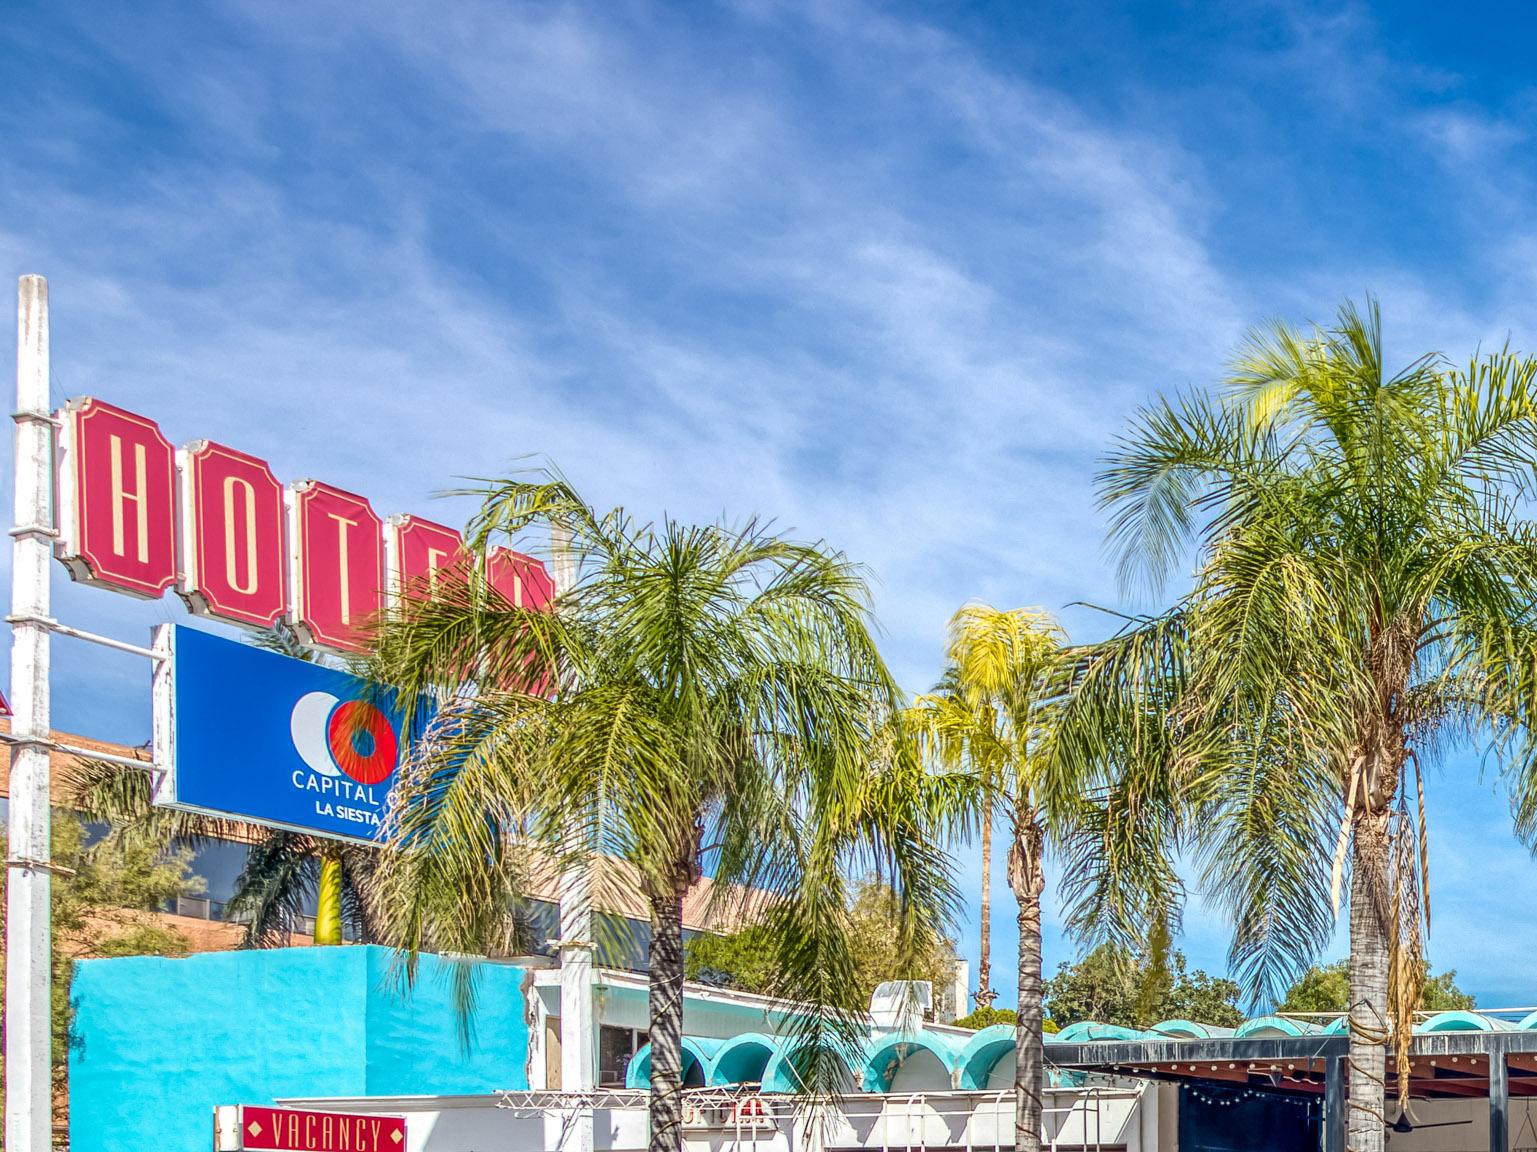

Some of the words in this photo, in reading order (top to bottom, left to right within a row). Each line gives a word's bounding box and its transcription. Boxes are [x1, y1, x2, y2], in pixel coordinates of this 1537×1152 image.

[292, 770, 379, 806] CAPITAL
[316, 800, 334, 817] LA
[337, 805, 381, 826] SIESTA
[272, 1113, 381, 1152] VACANCY
